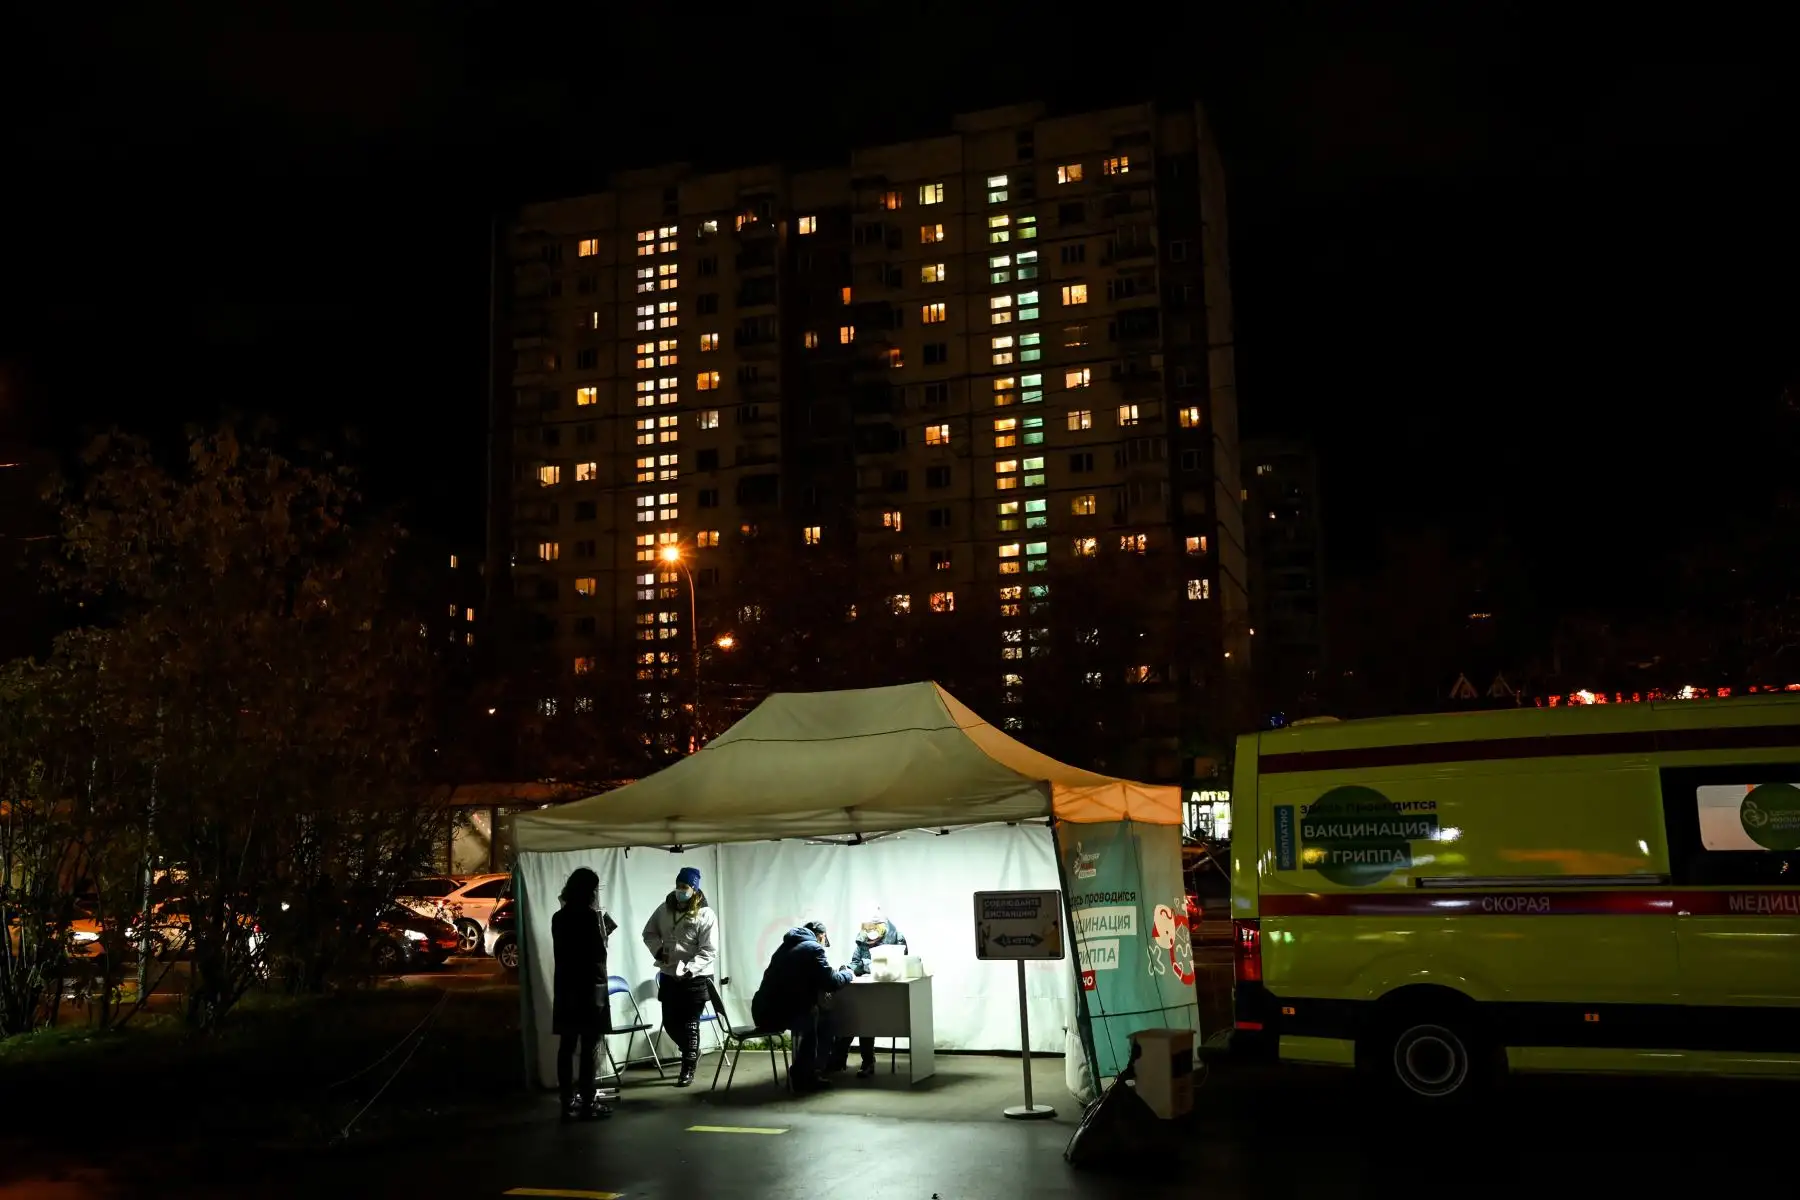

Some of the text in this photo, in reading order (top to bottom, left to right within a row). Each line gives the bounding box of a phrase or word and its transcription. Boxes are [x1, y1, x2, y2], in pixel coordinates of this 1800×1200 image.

[1304, 821, 1431, 838] ВАКЦИНАЦИЯ
[1333, 849, 1406, 864] ГРИППА
[1482, 893, 1800, 914] СКОРАЯ МЕДИЦ
[1079, 947, 1116, 965] РИППА
